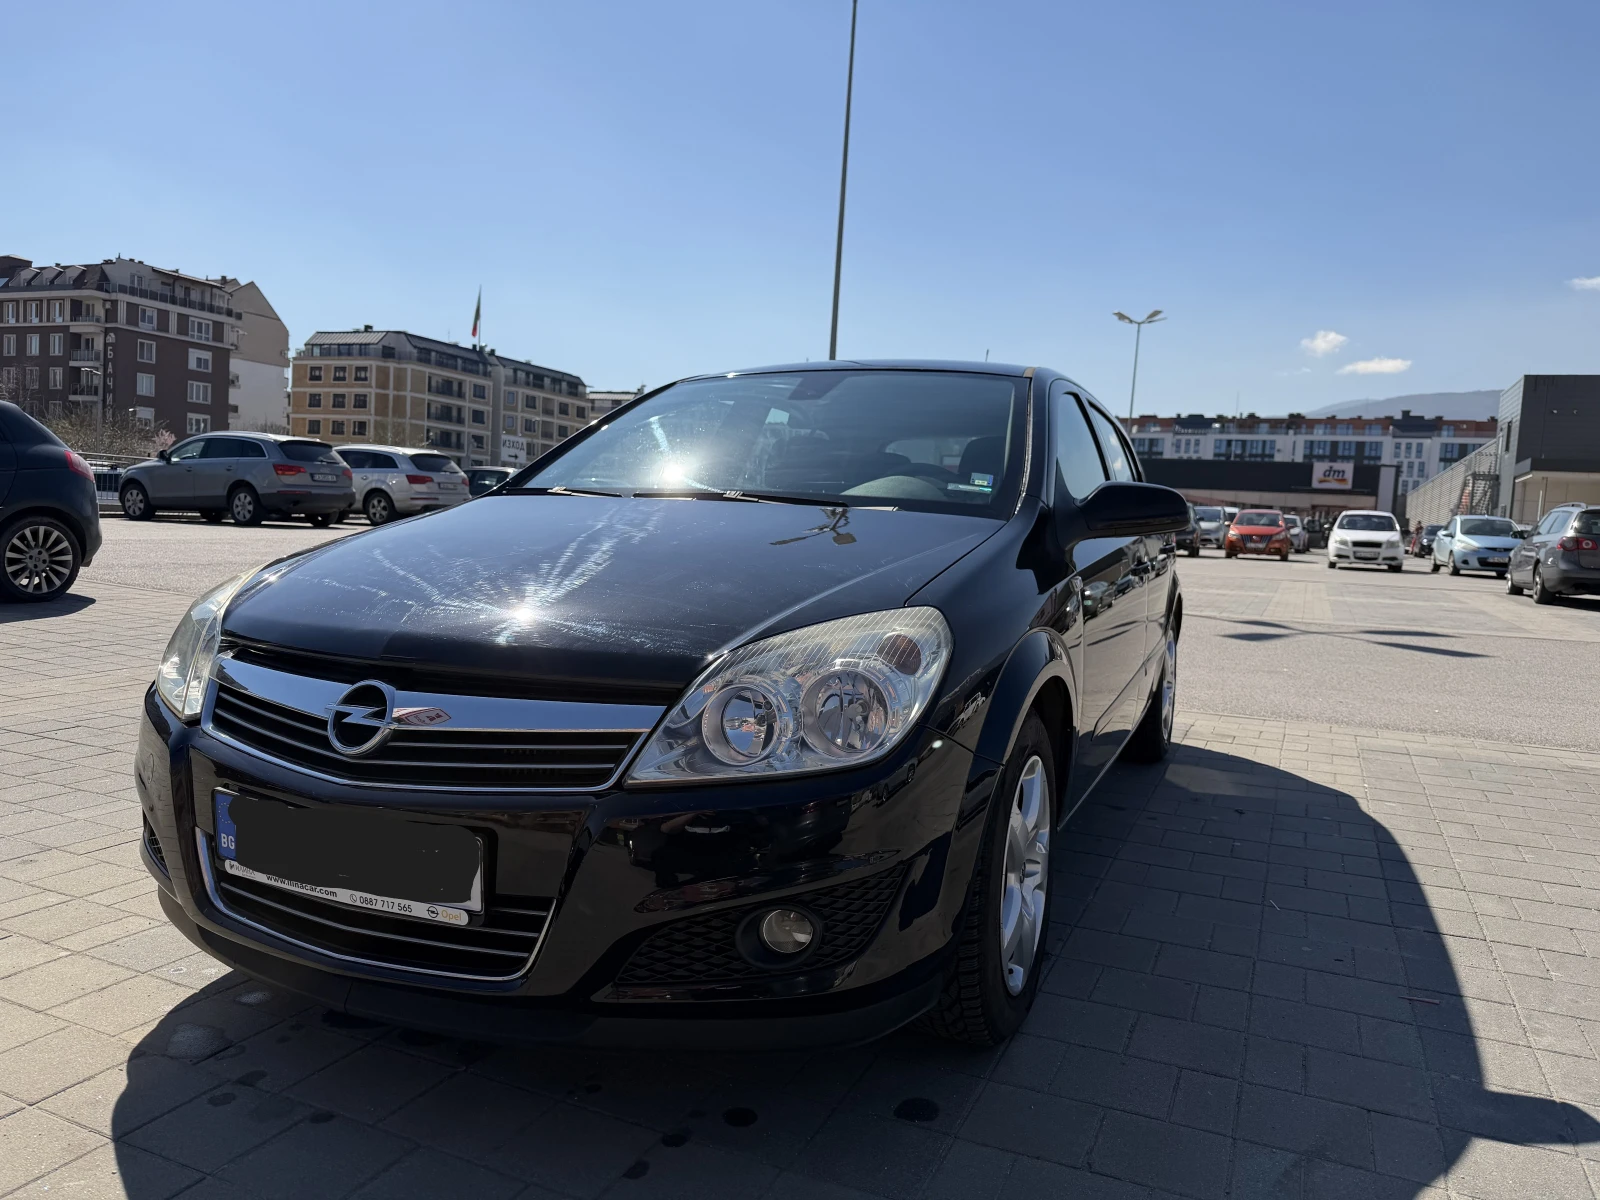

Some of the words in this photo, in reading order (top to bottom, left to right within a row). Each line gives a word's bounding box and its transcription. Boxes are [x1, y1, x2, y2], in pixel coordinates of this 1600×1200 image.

[502, 439, 525, 451] ИЗХОД
[1323, 465, 1346, 478] dm
[220, 833, 235, 849] BG
[359, 896, 378, 906] 0887
[380, 900, 395, 909] 717
[397, 903, 413, 913] 565
[441, 909, 462, 921] Opel
